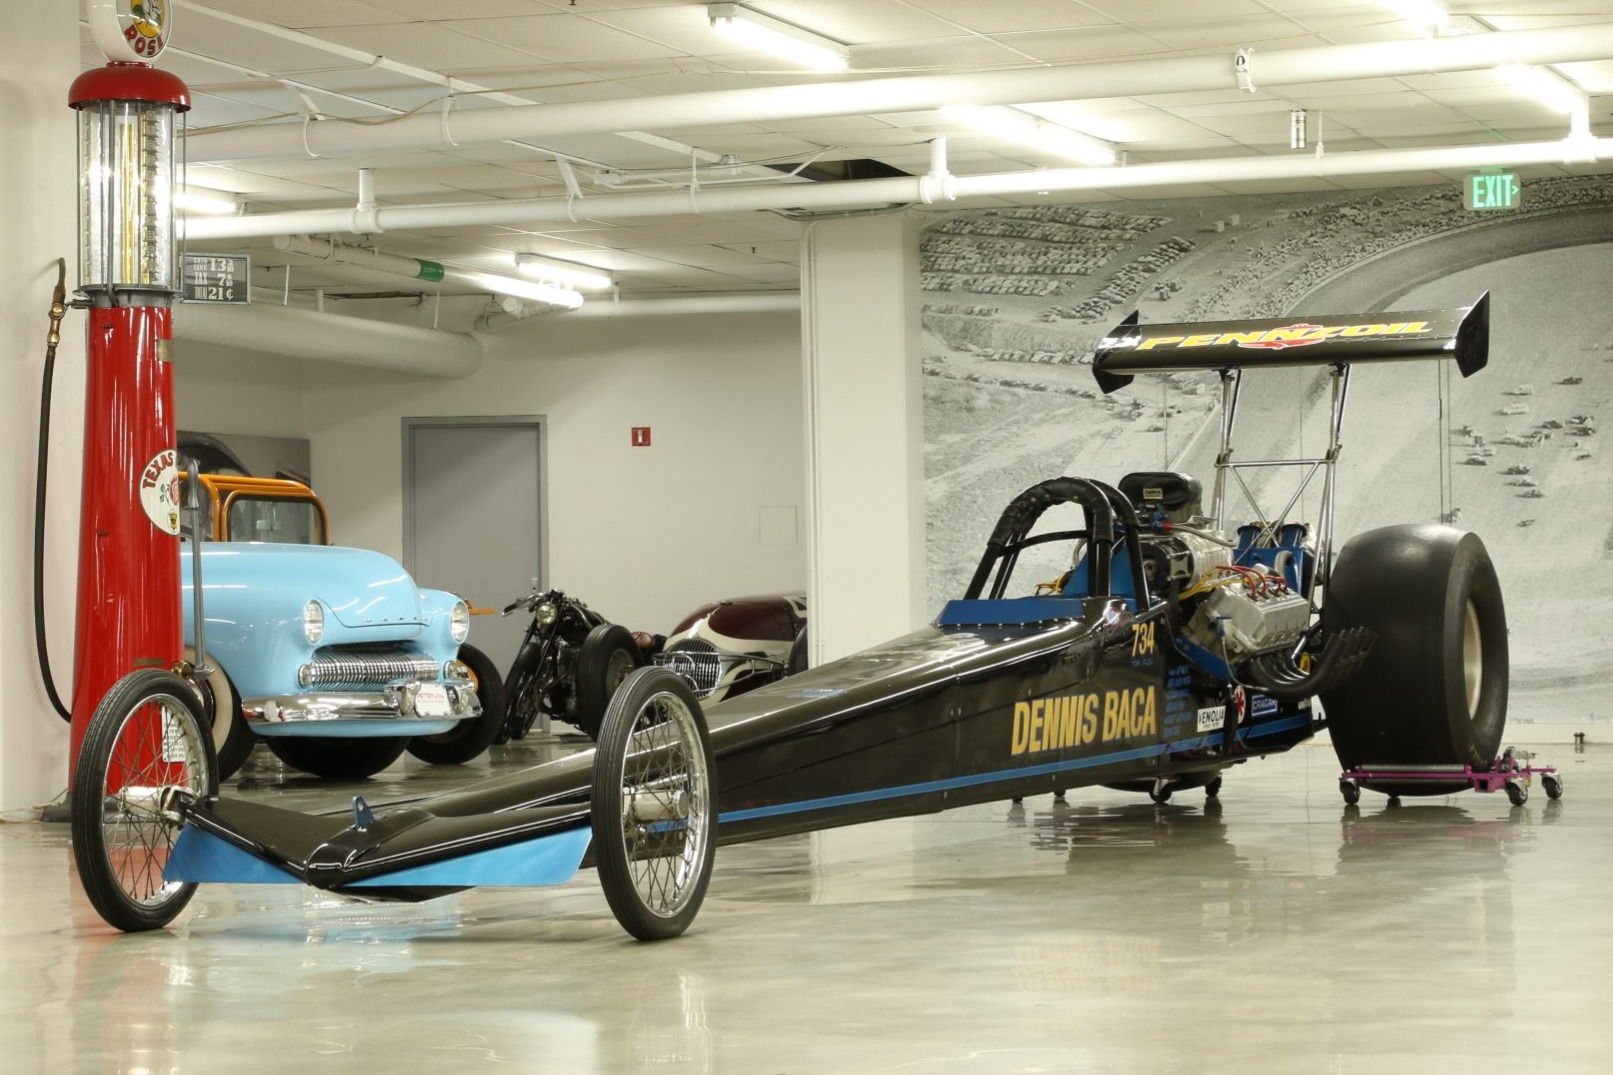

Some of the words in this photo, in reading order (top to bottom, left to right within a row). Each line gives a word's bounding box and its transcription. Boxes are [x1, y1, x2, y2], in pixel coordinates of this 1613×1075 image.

[1473, 174, 1514, 208] EXIT
[194, 272, 208, 285] TAX
[217, 273, 226, 286] 7
[210, 258, 226, 271] 13
[1134, 321, 1433, 350] PENNZOIL
[142, 451, 174, 489] TEXAS
[1131, 621, 1155, 657] 734
[1011, 693, 1099, 756] DENNIS
[1102, 685, 1156, 742] BACA
[1199, 709, 1225, 724] VENOLIA
